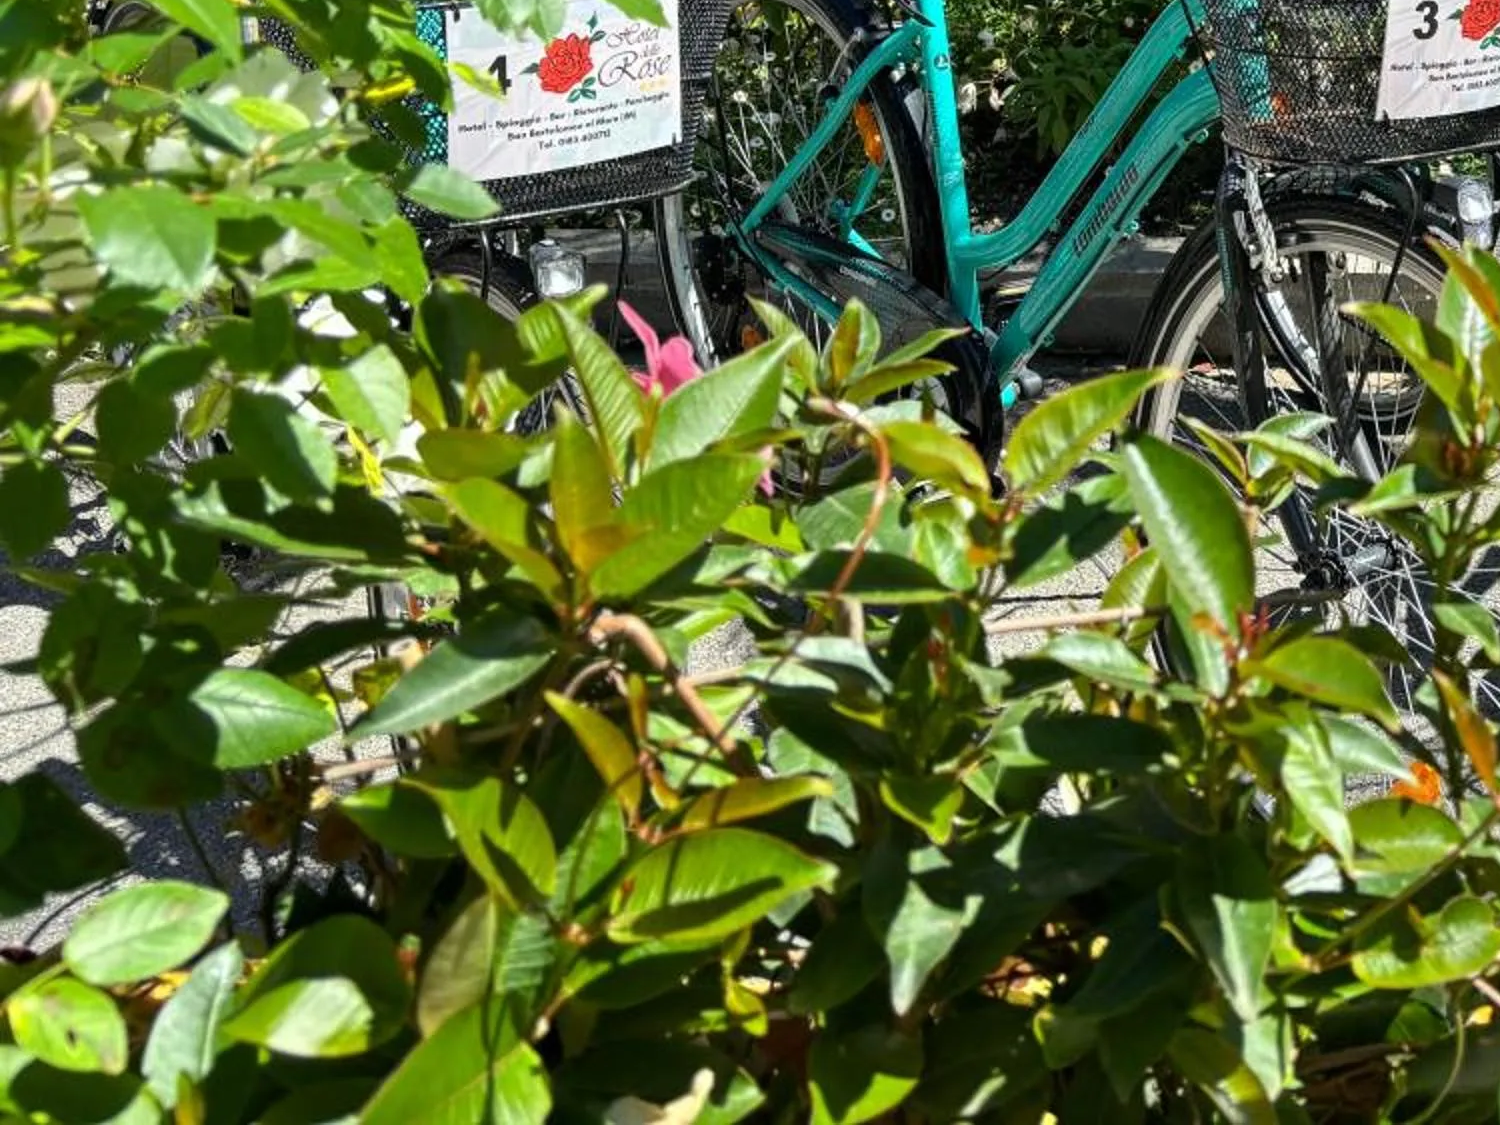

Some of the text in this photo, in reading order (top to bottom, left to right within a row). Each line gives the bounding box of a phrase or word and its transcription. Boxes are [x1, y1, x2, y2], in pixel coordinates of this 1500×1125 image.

[1413, 0, 1438, 39] 3
[487, 55, 512, 96] 4
[598, 50, 672, 87] Rose
